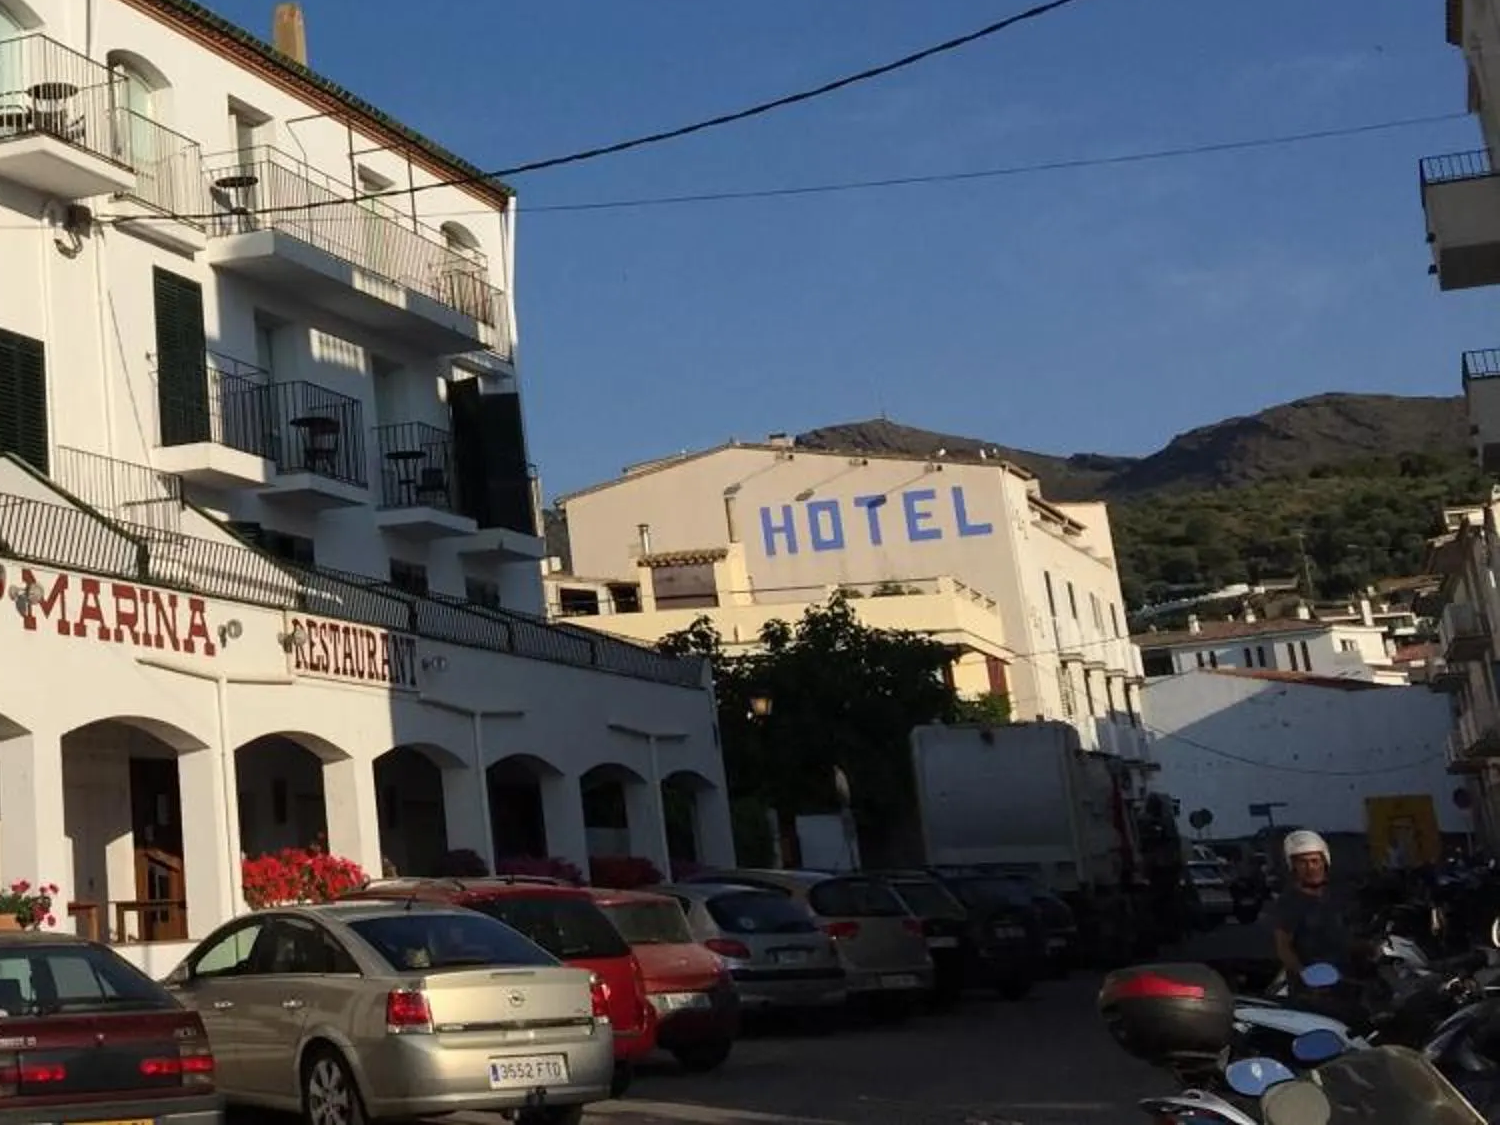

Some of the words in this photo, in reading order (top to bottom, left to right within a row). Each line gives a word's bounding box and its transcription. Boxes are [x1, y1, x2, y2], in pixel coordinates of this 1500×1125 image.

[759, 486, 993, 557] HOTEL
[21, 568, 216, 656] MARINA
[291, 618, 417, 687] RESTAURANT
